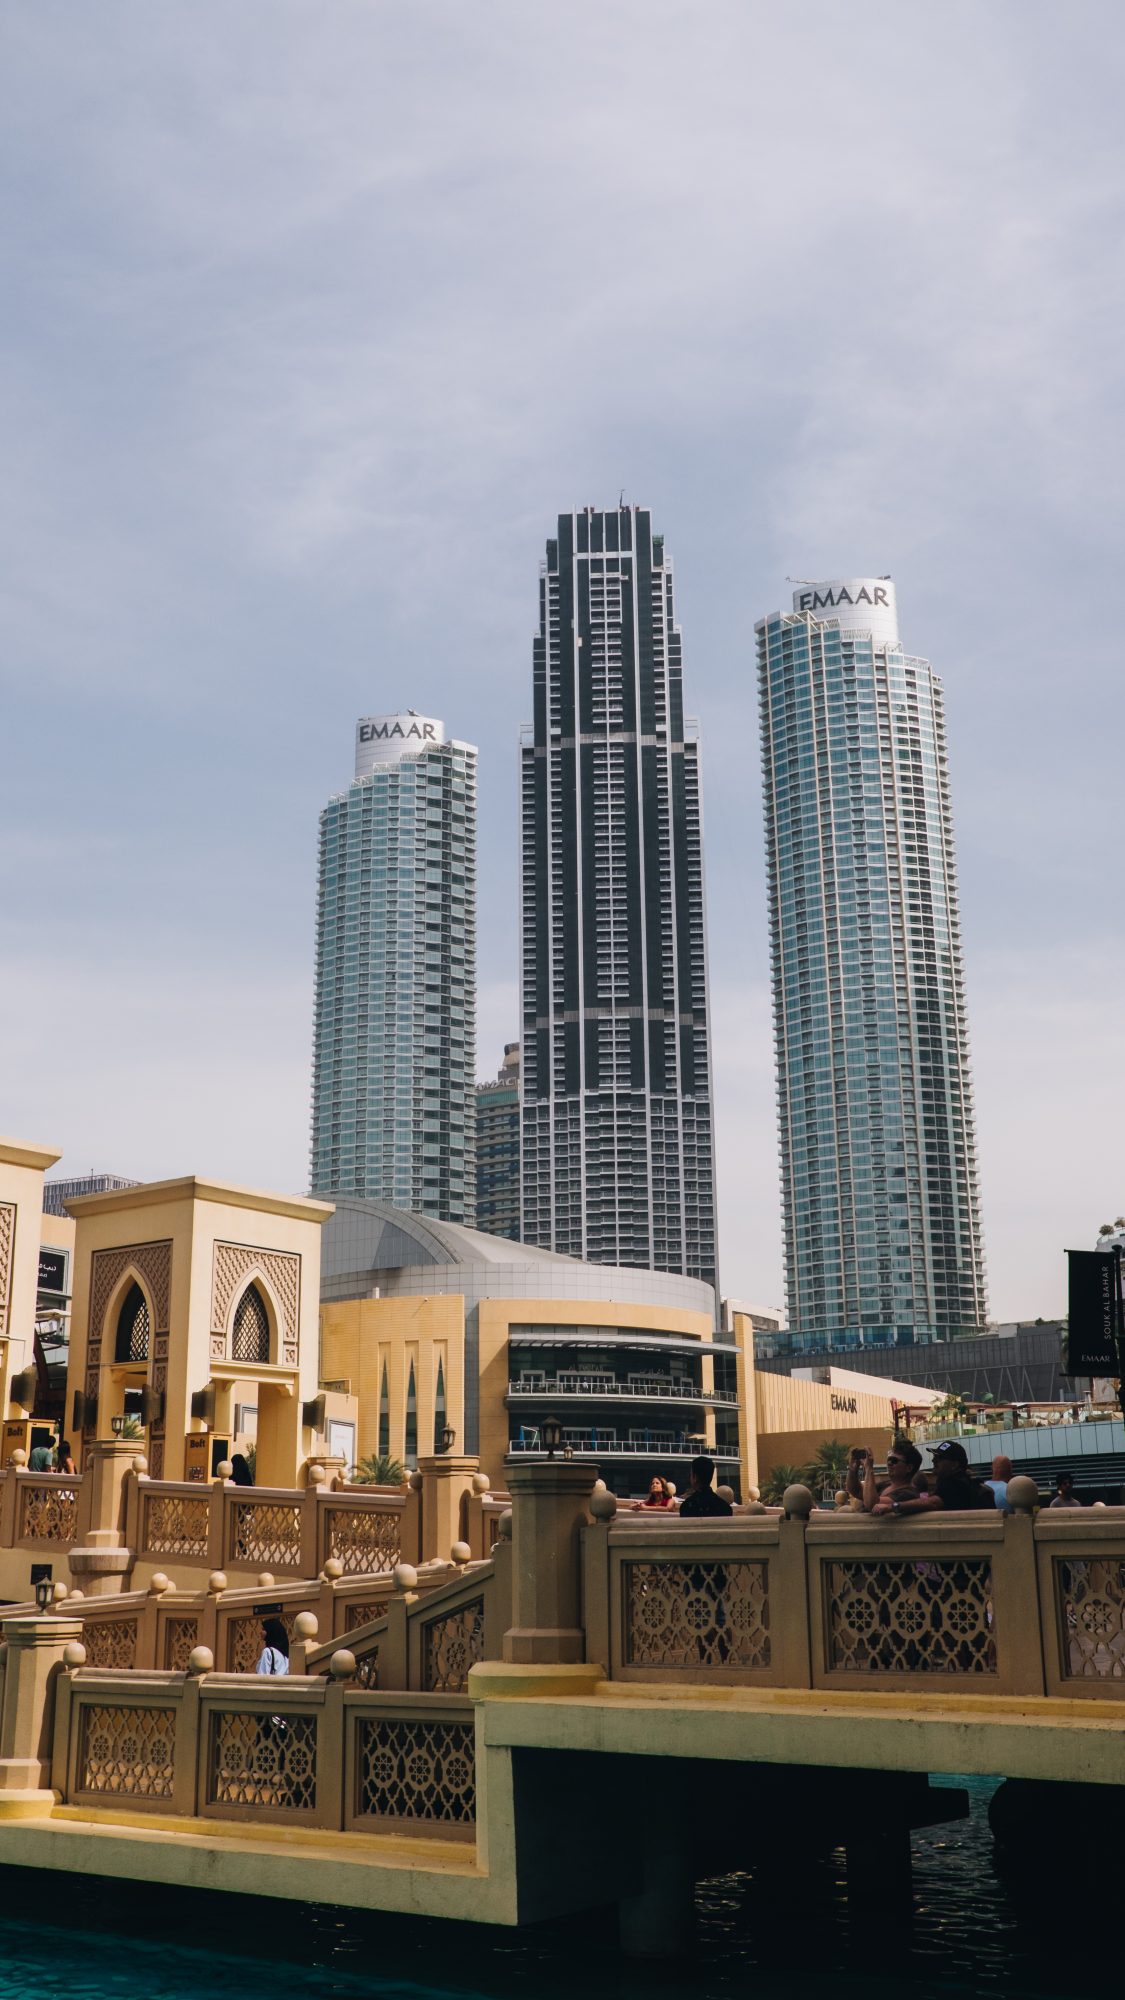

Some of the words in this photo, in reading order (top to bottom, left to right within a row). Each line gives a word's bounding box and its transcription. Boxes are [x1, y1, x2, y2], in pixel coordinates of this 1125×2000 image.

[800, 586, 889, 610] EMAAR
[360, 722, 436, 742] EMAAR
[1101, 1266, 1110, 1298] BAHAR
[1103, 1300, 1111, 1312] AL
[1103, 1314, 1112, 1340] SOUK
[1081, 1353, 1110, 1362] EMAAR
[831, 1394, 857, 1414] EMAAR
